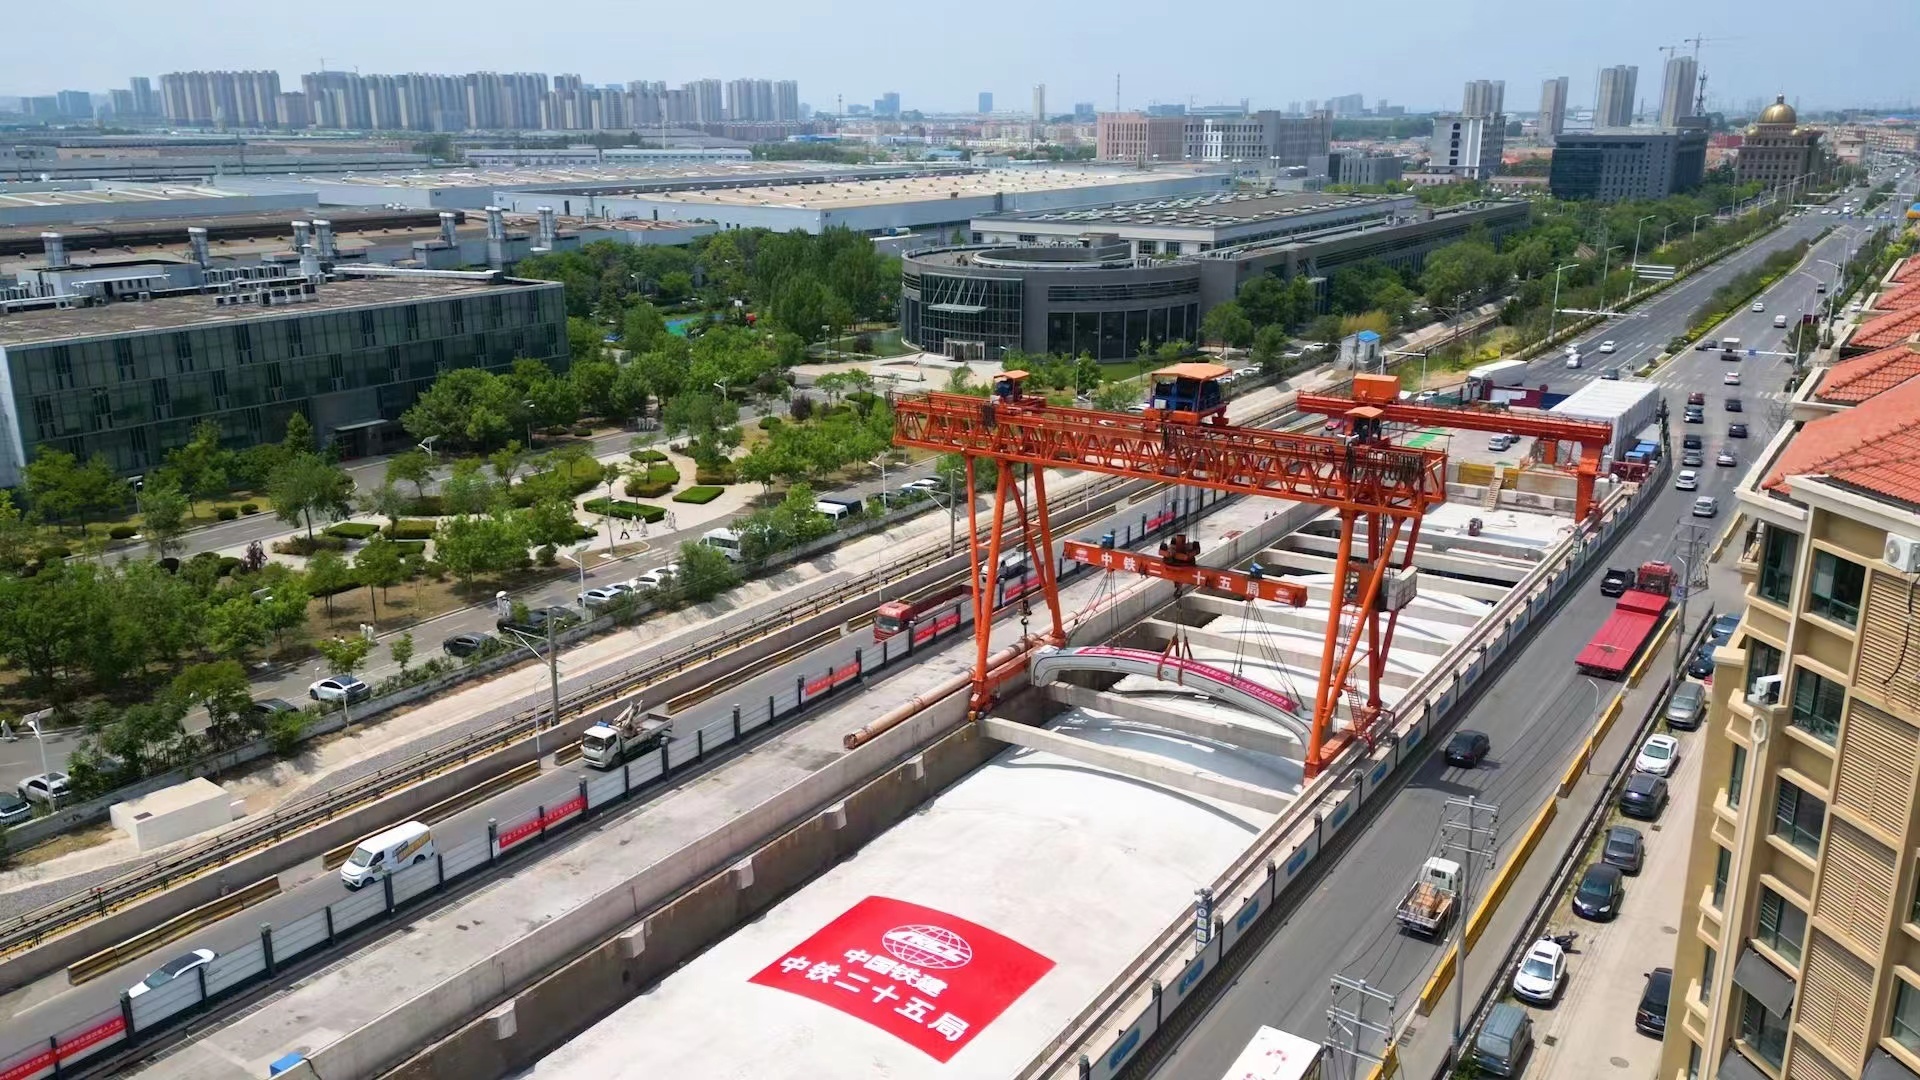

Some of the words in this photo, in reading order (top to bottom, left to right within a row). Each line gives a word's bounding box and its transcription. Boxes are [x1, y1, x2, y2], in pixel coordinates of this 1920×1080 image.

[1101, 552, 1260, 597] 中铁二十五局
[843, 948, 948, 998] 中国铁建
[779, 955, 970, 1042] 中铁二十五局
